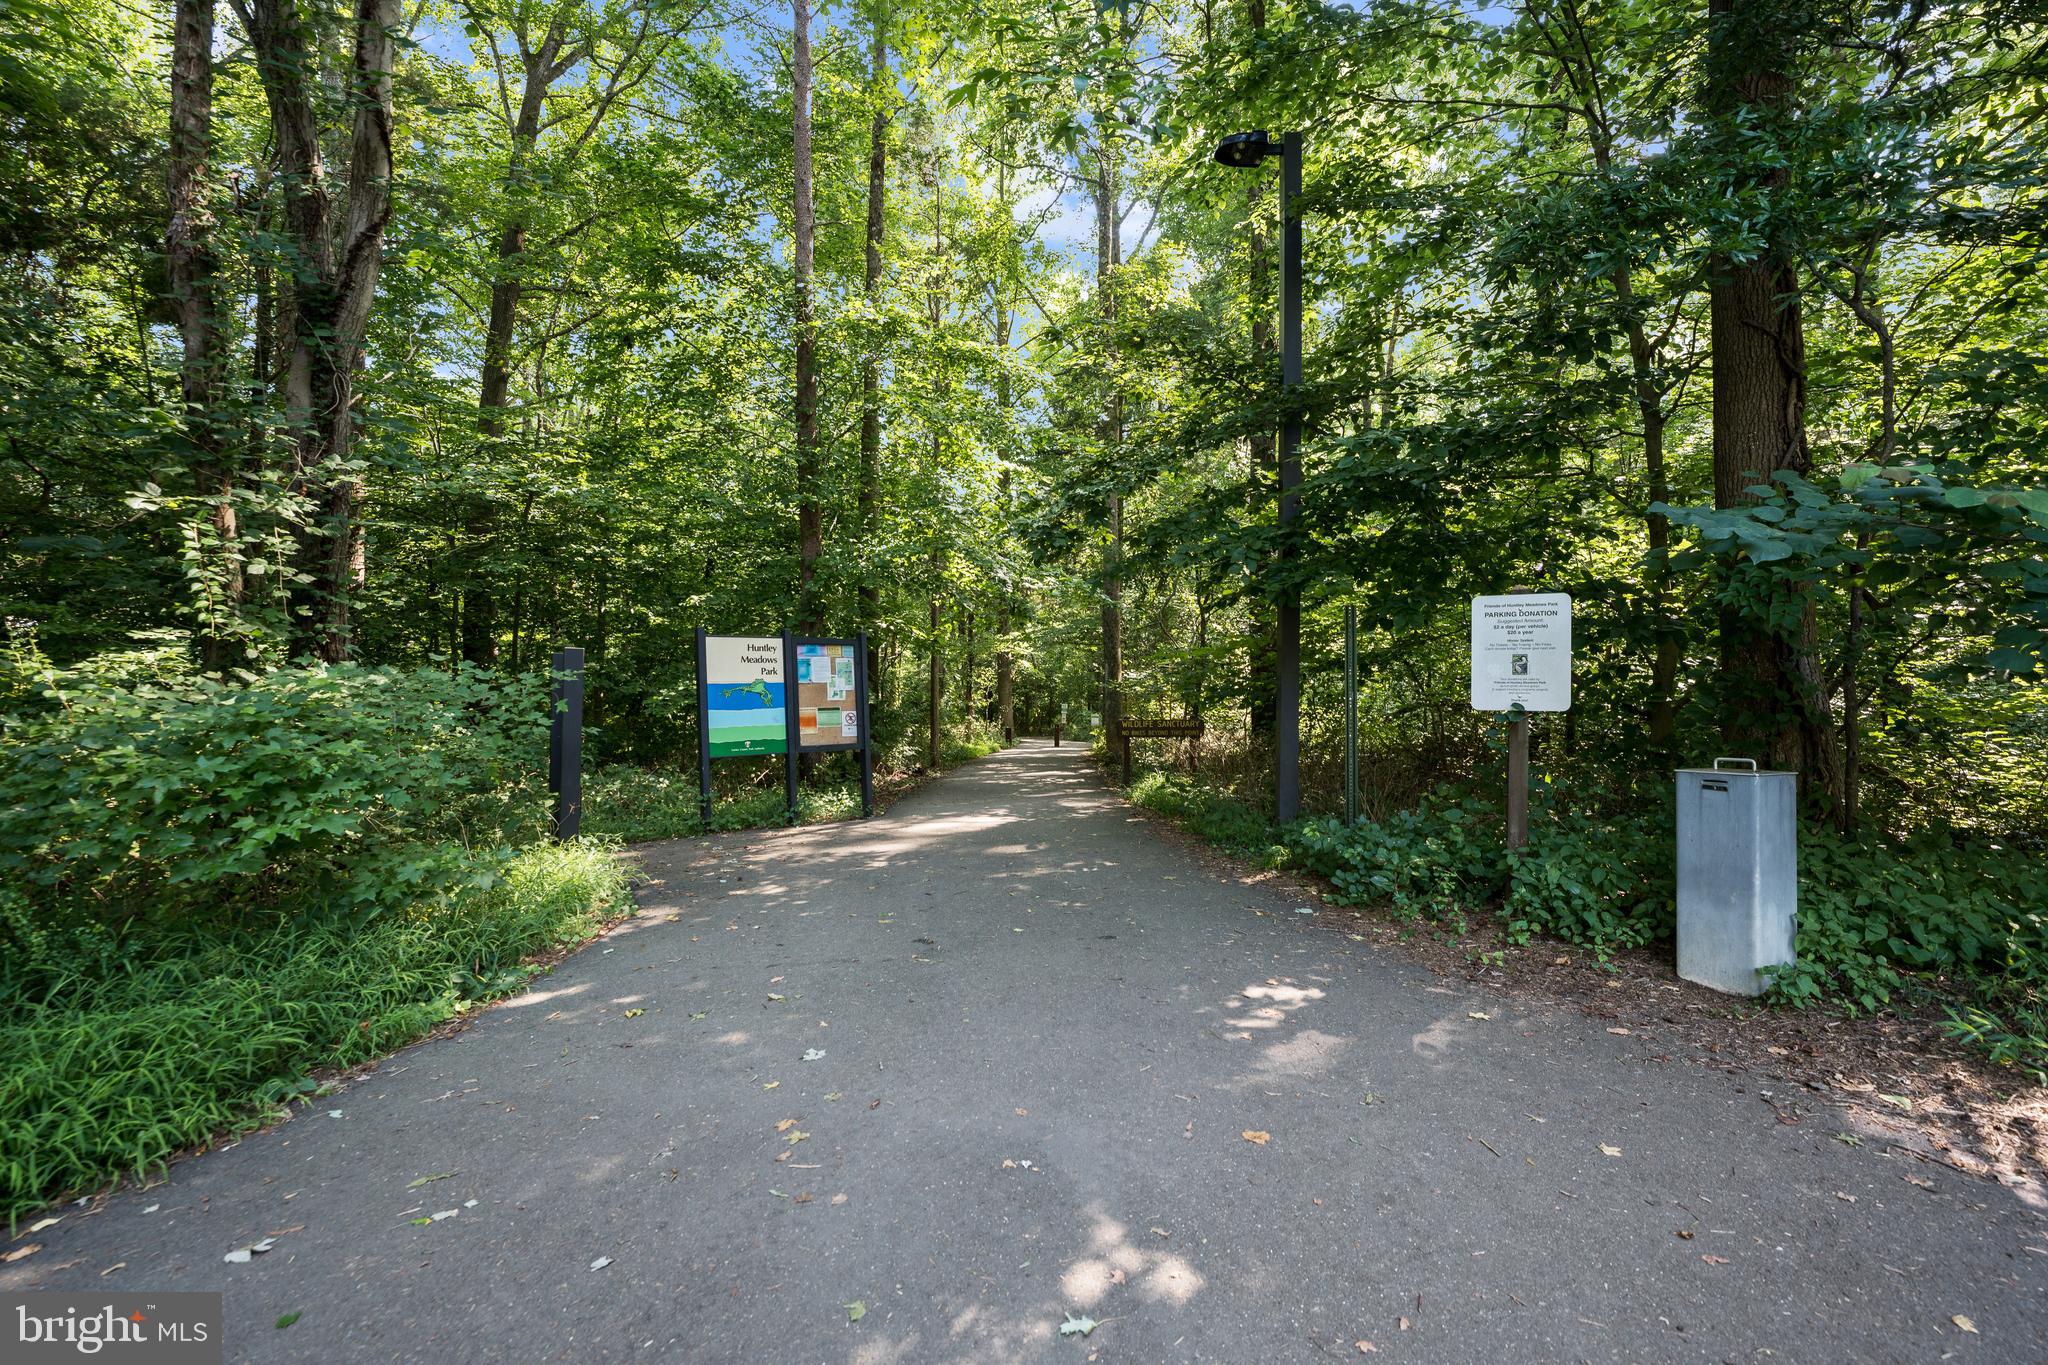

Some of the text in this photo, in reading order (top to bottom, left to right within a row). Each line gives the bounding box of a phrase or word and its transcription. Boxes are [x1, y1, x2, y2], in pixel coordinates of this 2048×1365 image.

[747, 643, 777, 654] Huntley
[740, 655, 778, 664] Meadows
[761, 667, 778, 675] Park
[1121, 720, 1200, 728] WILDLIFE SANCTUARY
